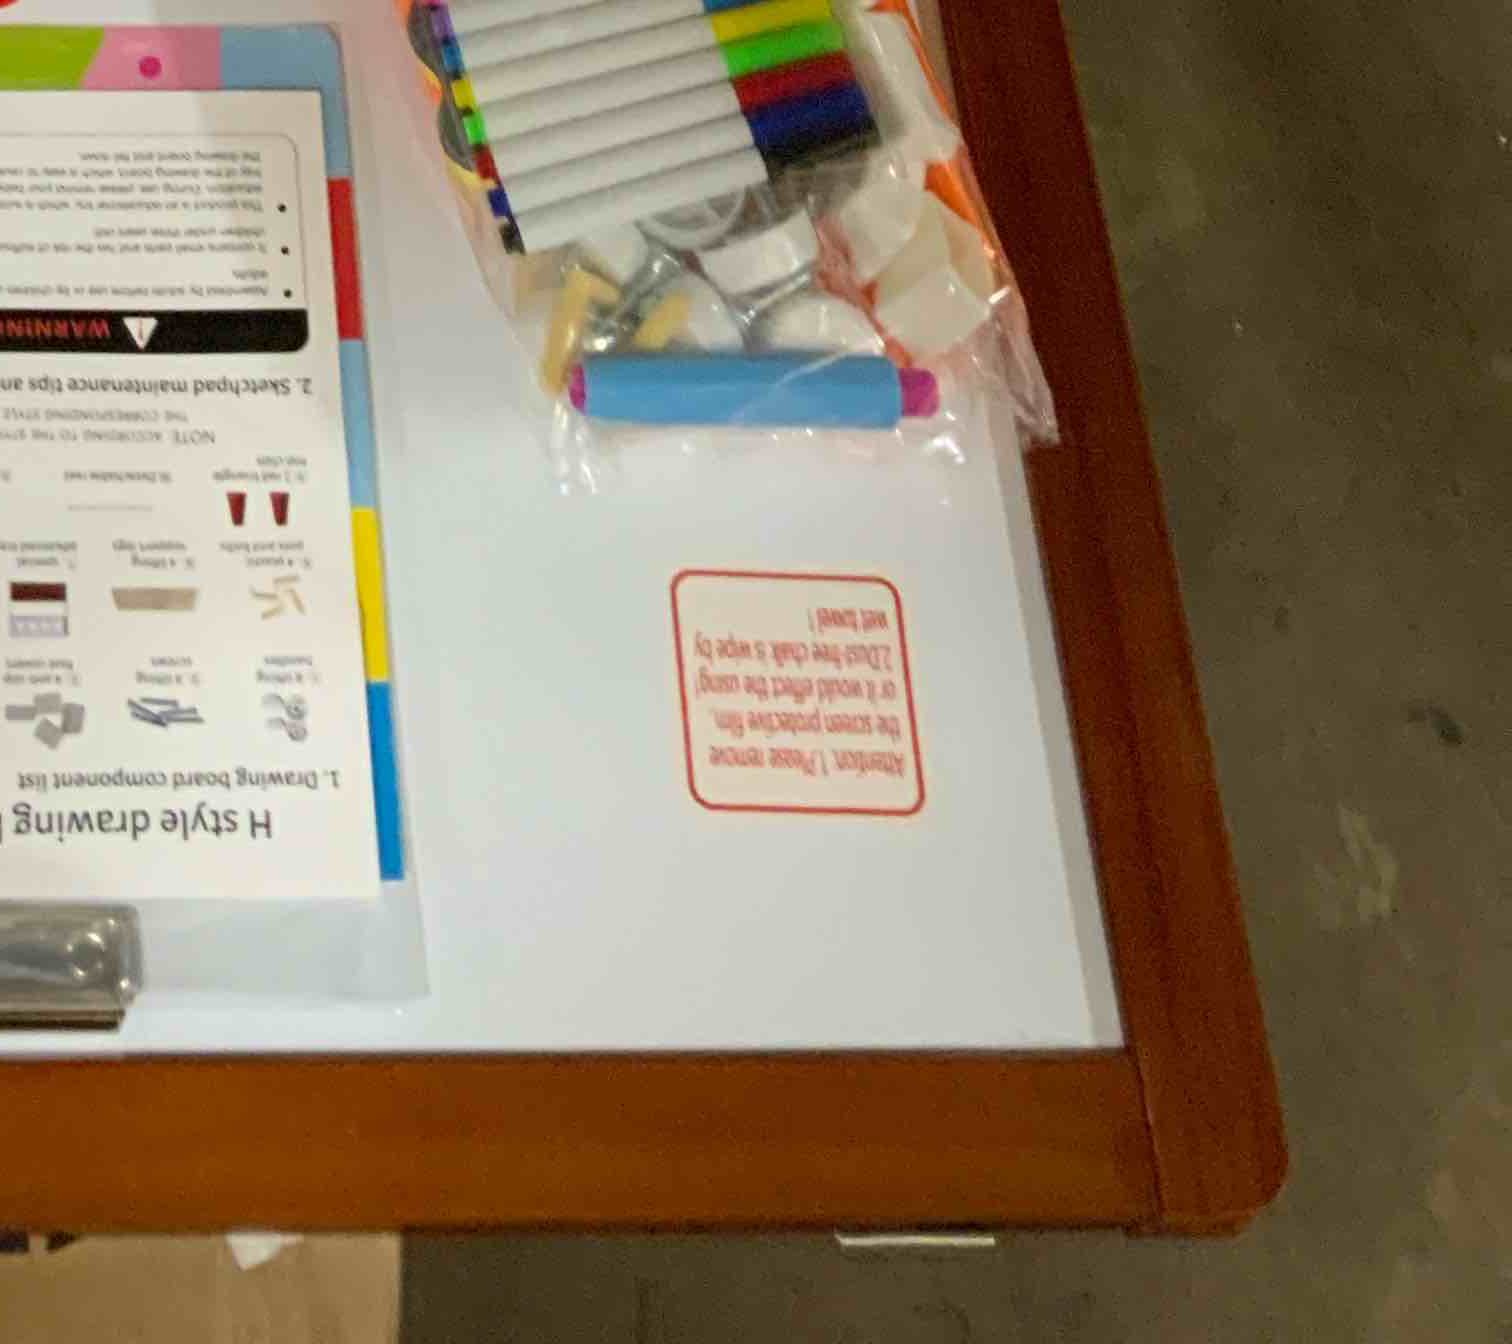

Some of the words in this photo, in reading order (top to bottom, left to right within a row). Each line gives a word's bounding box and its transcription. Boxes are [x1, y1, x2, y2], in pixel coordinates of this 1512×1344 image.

[27, 374, 63, 394] tips
[66, 377, 188, 396] maintenance
[192, 375, 291, 397] Sketchpad
[694, 630, 713, 660] by
[743, 675, 769, 702] the
[817, 678, 863, 703] would
[748, 709, 822, 737] protective
[824, 712, 873, 735] screen
[876, 715, 901, 742] the
[17, 772, 48, 792] list
[52, 766, 167, 791] component
[173, 771, 231, 791] board
[235, 766, 318, 790] Drawing
[324, 770, 340, 788] 1.
[11, 801, 151, 844] drawing
[160, 801, 239, 842] style
[249, 809, 272, 839] H
